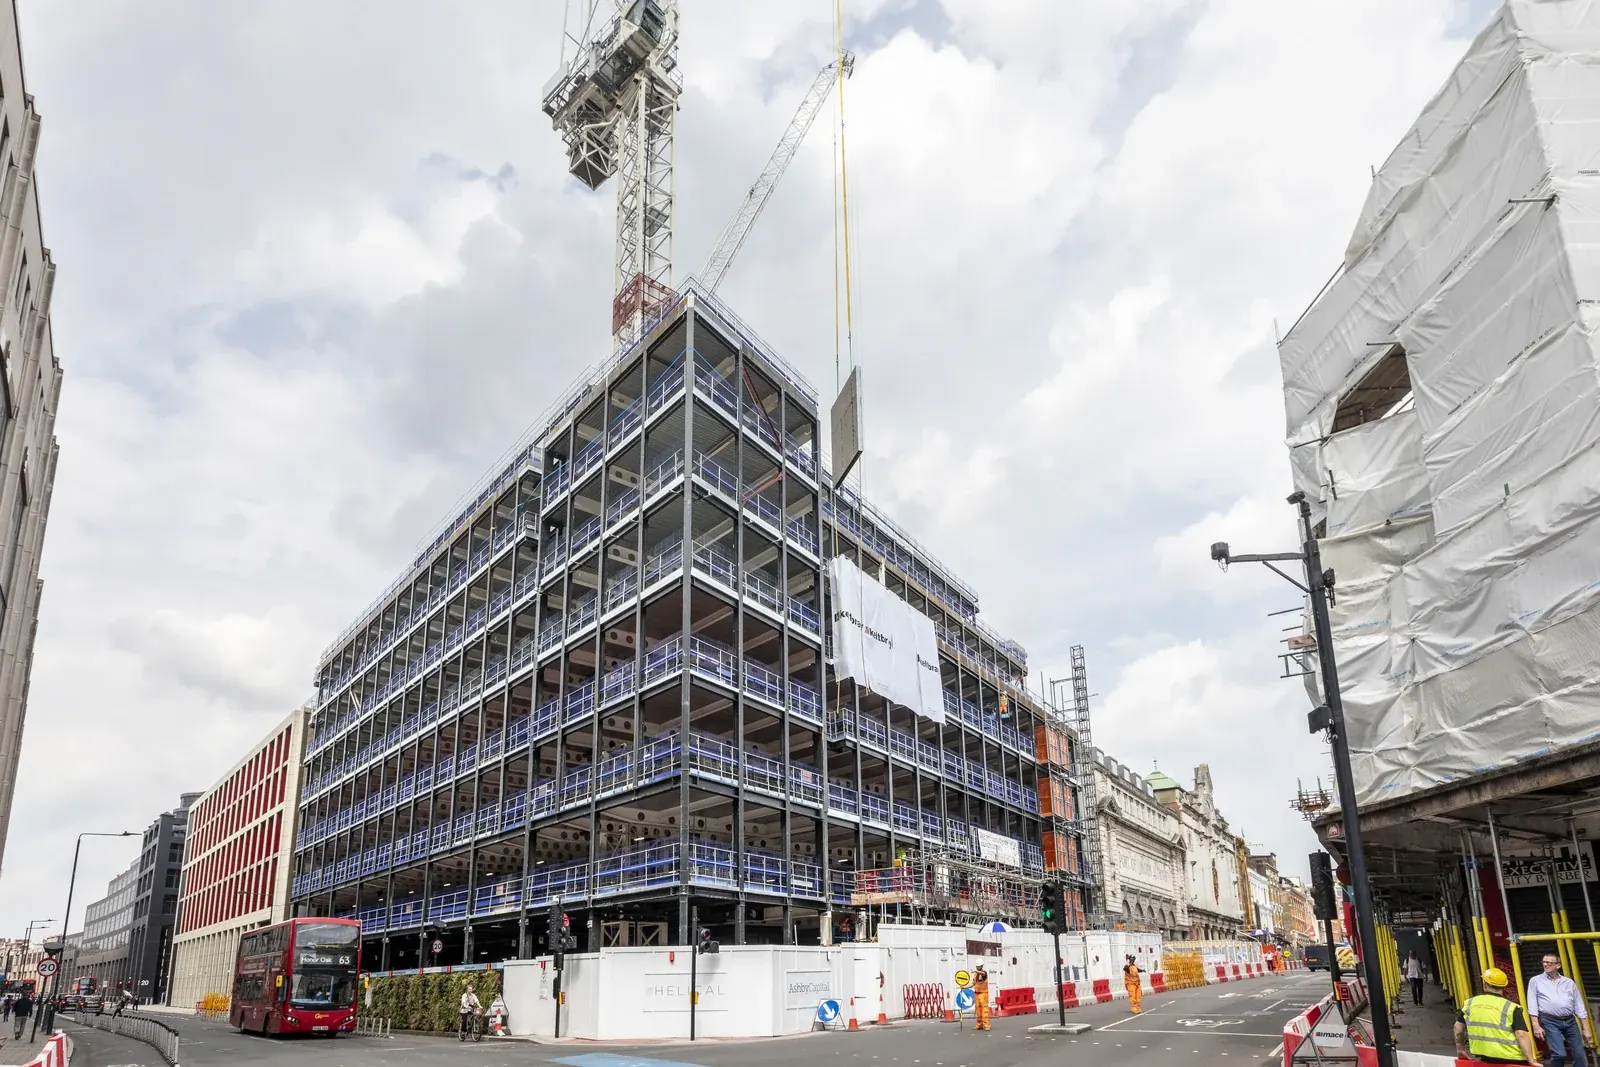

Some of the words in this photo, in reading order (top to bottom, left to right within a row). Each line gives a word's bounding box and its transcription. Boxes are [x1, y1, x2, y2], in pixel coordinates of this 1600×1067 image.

[839, 609, 864, 631] ketbray
[1503, 875, 1531, 886] CITY
[1536, 868, 1591, 883] BRBER
[339, 956, 350, 964] 63
[40, 963, 55, 972] 20
[654, 985, 726, 996] HELICAL
[788, 982, 830, 994] AshbyCapital
